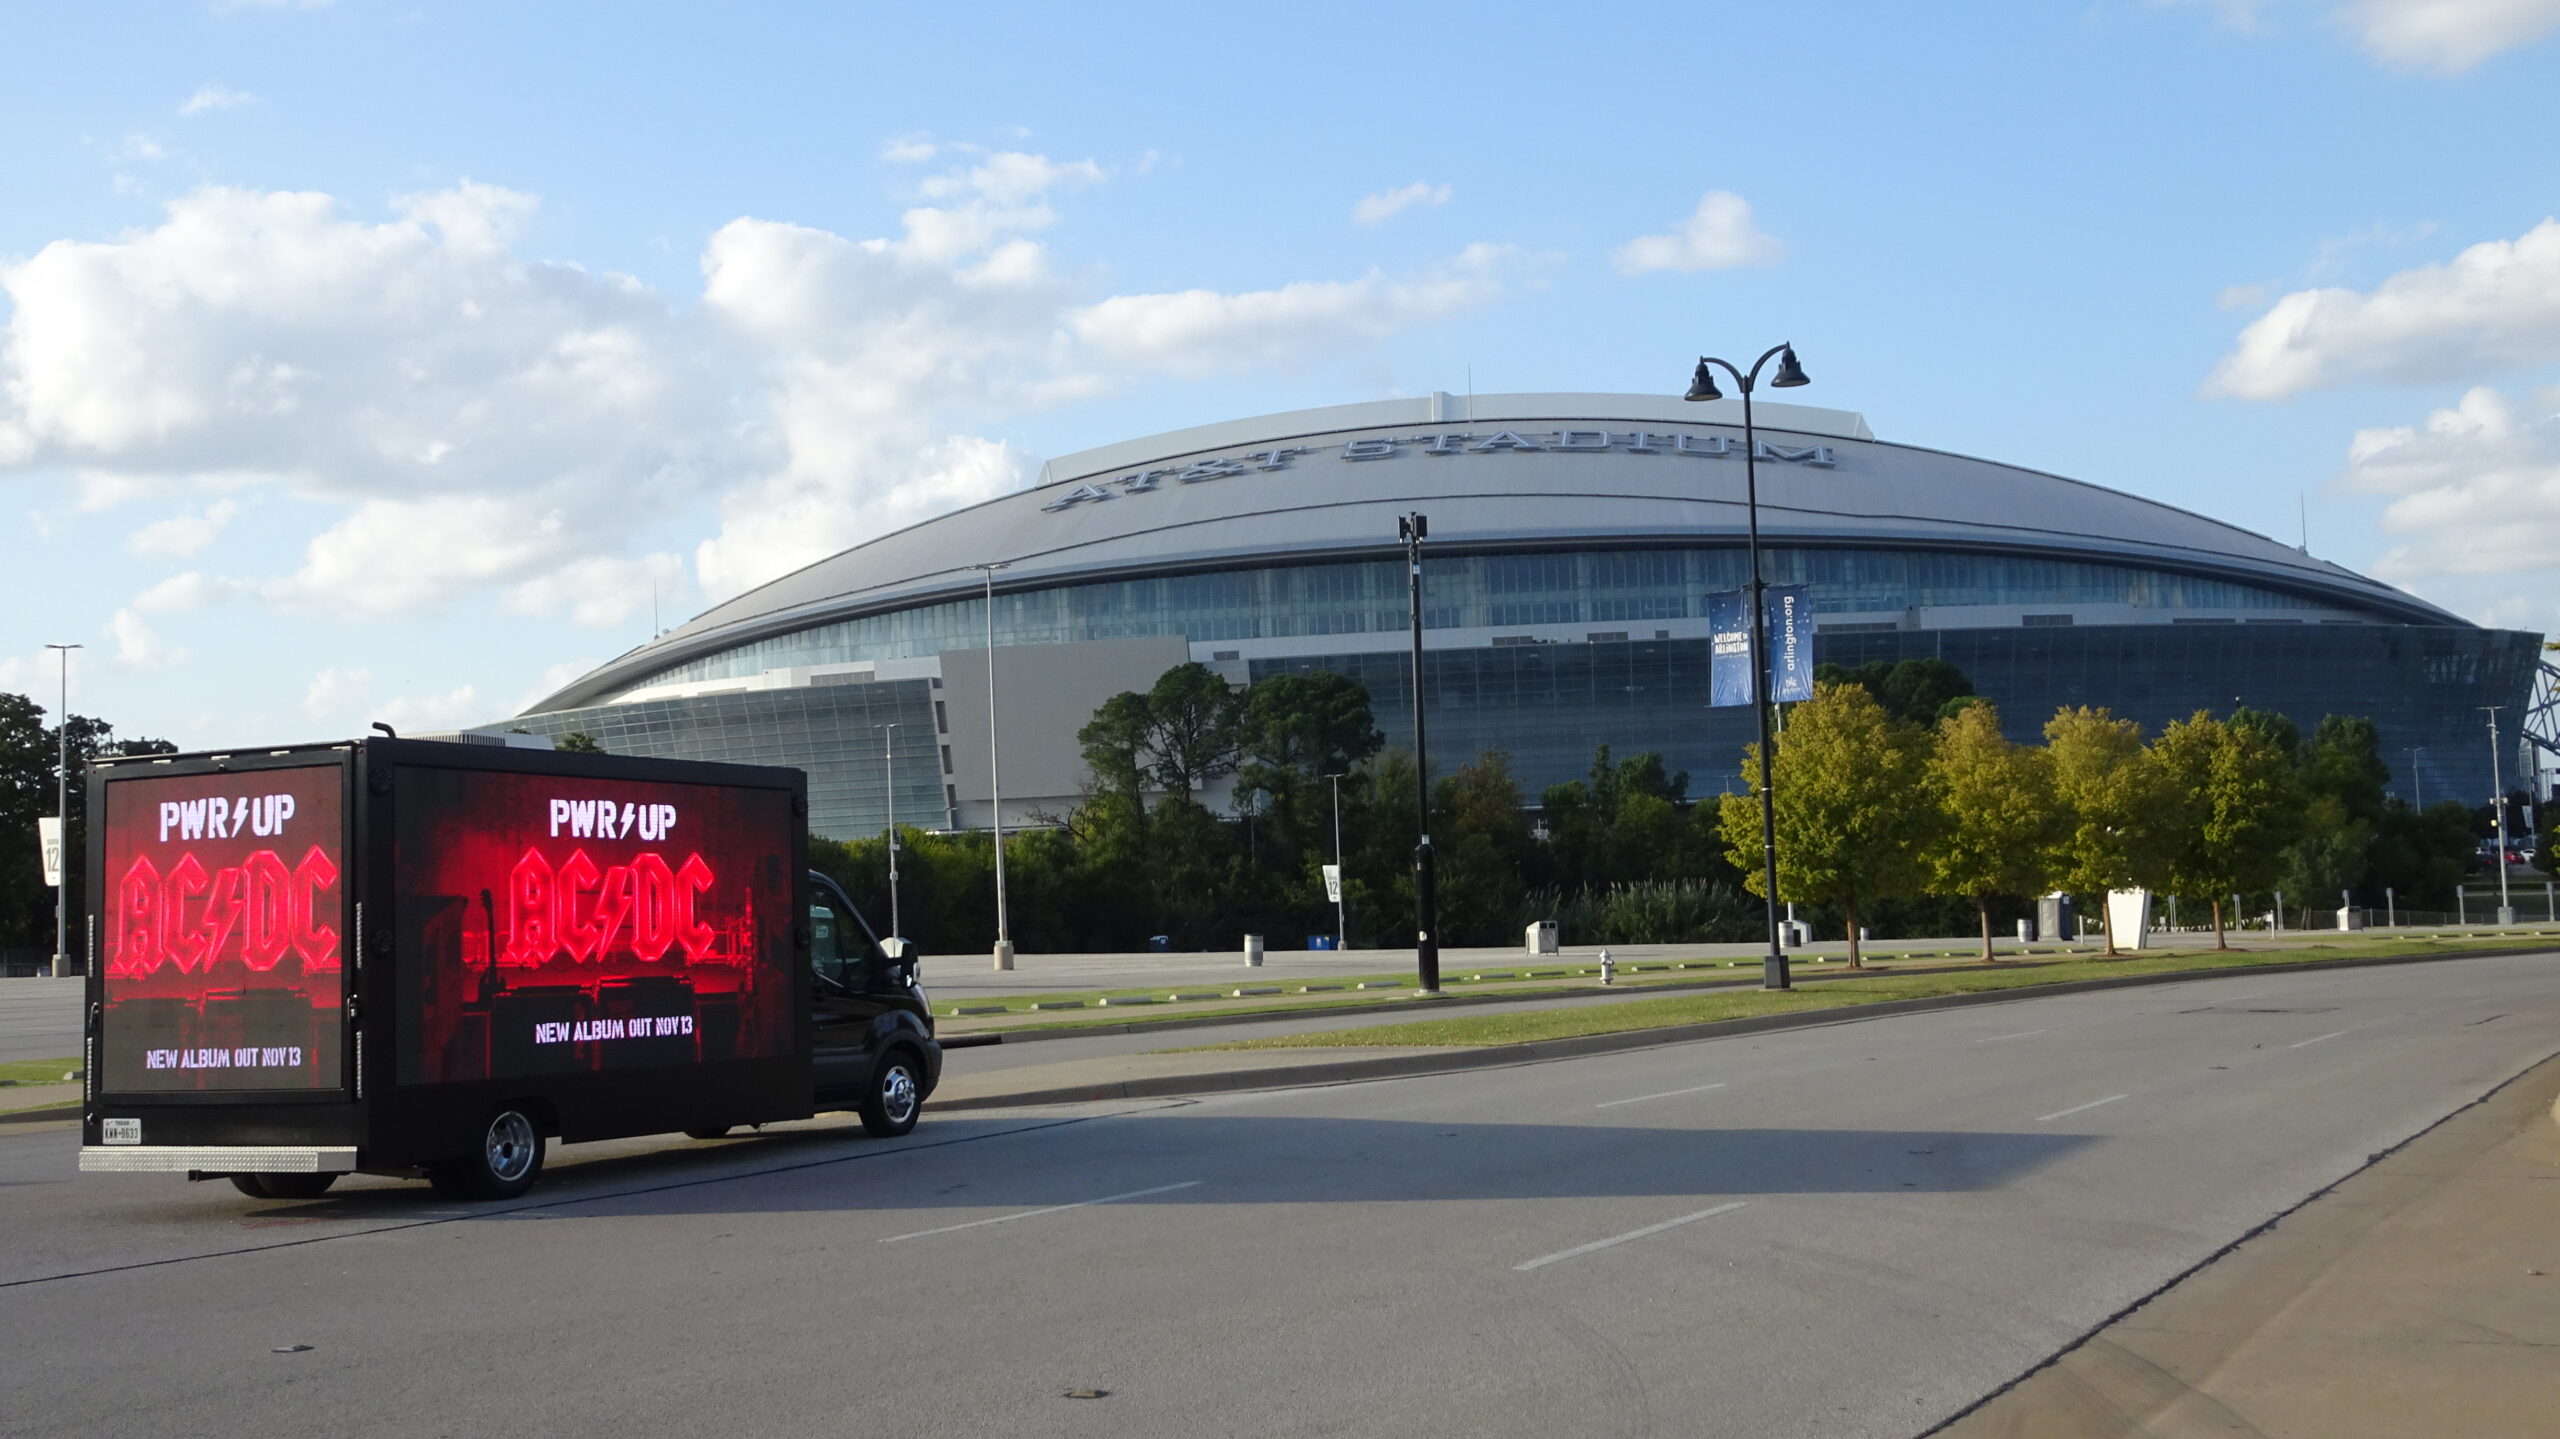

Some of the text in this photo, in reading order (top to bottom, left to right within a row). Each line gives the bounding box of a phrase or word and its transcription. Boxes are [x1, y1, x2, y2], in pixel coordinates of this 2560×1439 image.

[1041, 430, 1836, 512] AT&T STADIUM
[1784, 596, 1797, 671] arlington.org
[252, 794, 296, 837] UP
[638, 804, 677, 841] UP
[46, 847, 60, 873] 12
[1329, 880, 1339, 896] 12
[535, 1015, 693, 1044] NEW ALBUM OUT NOV 13
[146, 1046, 302, 1069] NEW ALBUM OUT NOV 13
